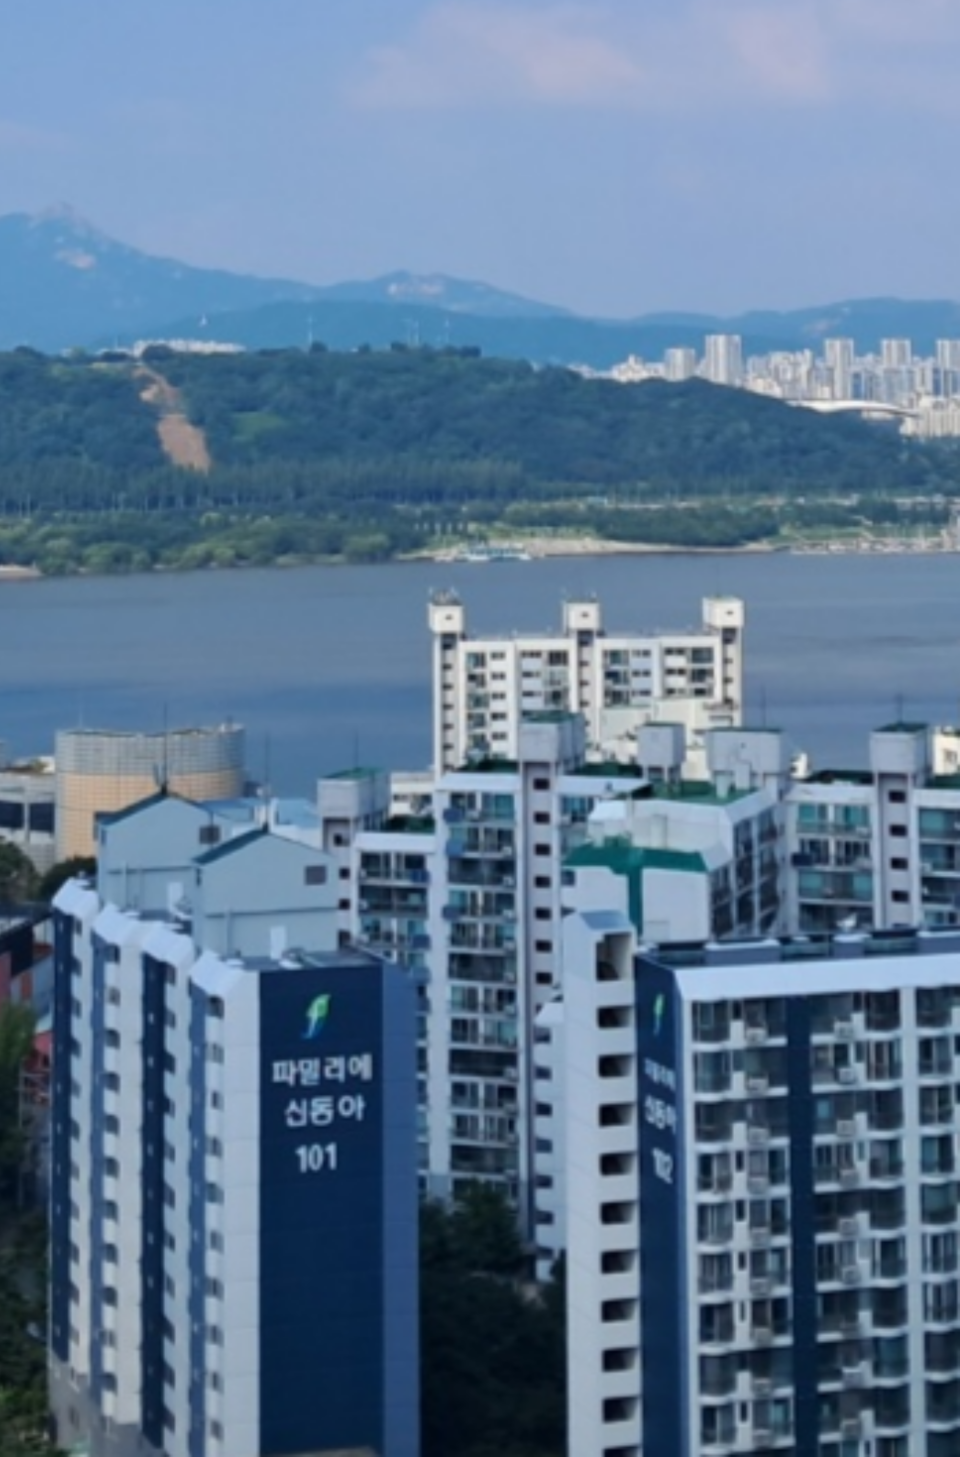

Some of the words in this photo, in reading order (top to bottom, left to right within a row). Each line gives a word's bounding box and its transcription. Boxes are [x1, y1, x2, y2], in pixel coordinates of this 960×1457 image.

[272, 1053, 373, 1086] 파밀리에
[285, 1094, 366, 1127] 신동아
[295, 1142, 337, 1174] 101
